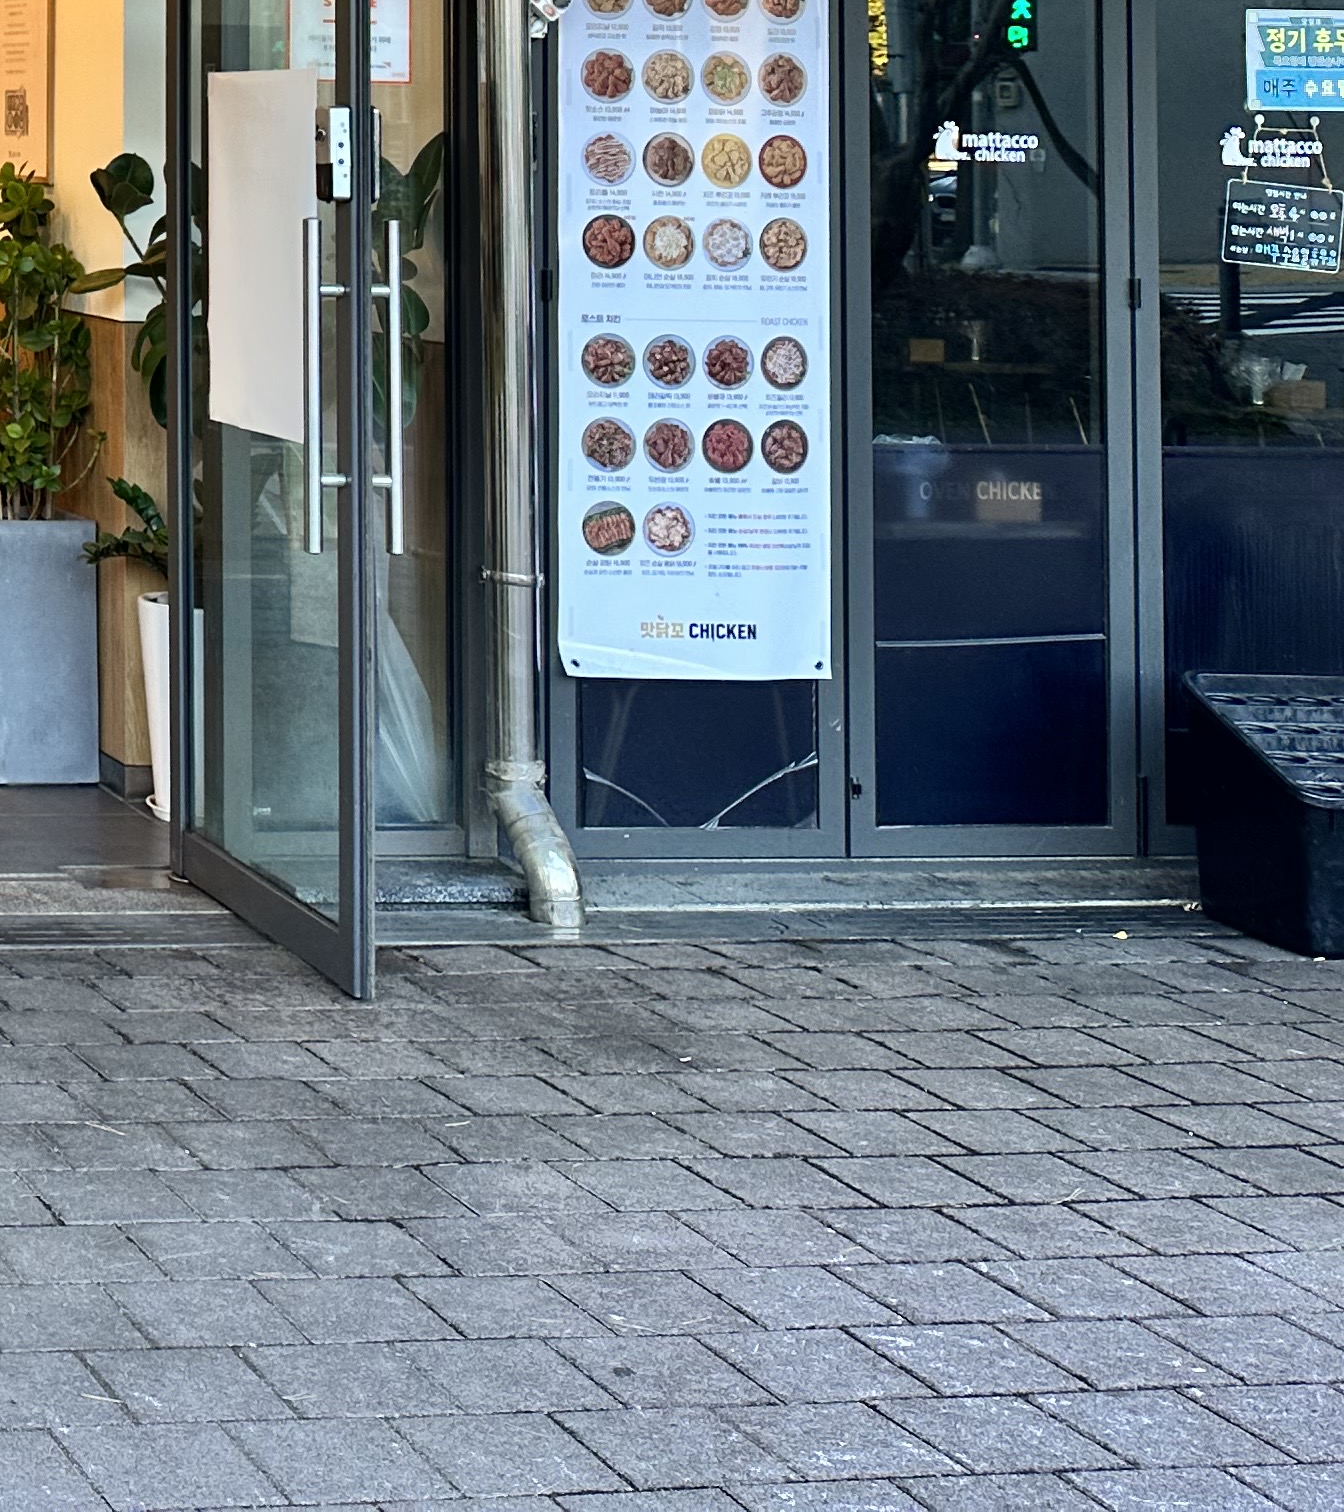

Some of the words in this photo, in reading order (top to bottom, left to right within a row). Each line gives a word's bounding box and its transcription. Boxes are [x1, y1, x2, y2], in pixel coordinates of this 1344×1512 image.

[1266, 27, 1307, 54] 정기
[1263, 78, 1297, 98] 매주
[962, 132, 1039, 149] mattacco
[1247, 138, 1323, 155] mattacco
[974, 147, 1026, 163] chicken
[1260, 154, 1311, 168] chicken
[1255, 243, 1281, 264] 매주
[640, 621, 685, 639] 맛닭꼬
[688, 623, 758, 642] CHICKEN
